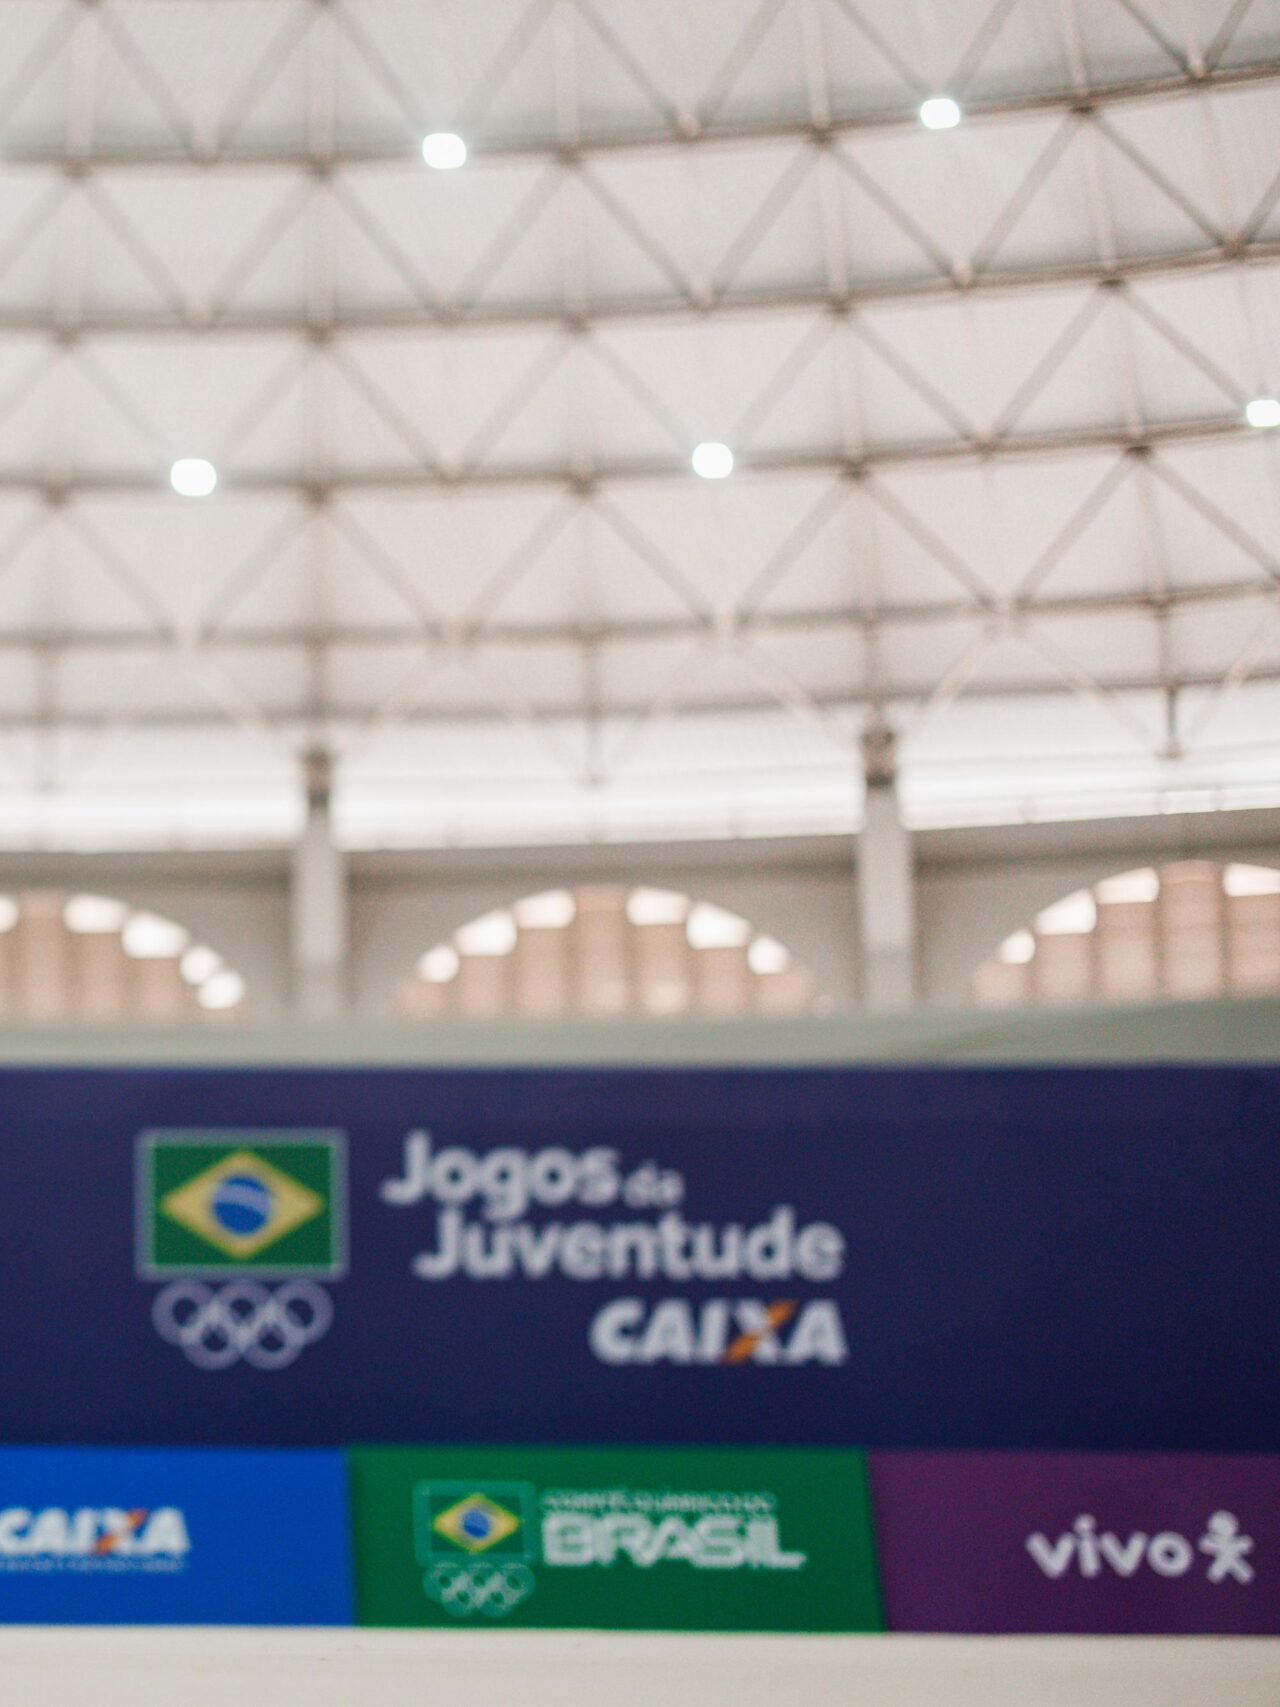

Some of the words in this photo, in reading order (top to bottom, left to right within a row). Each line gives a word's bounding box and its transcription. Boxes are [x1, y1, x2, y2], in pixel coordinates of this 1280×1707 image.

[381, 1129, 620, 1221] Jogos
[413, 1205, 846, 1281] Juventude
[588, 1299, 847, 1366] CAIXA
[540, 1511, 807, 1570] BRASIL
[1024, 1512, 1195, 1579] vivo
